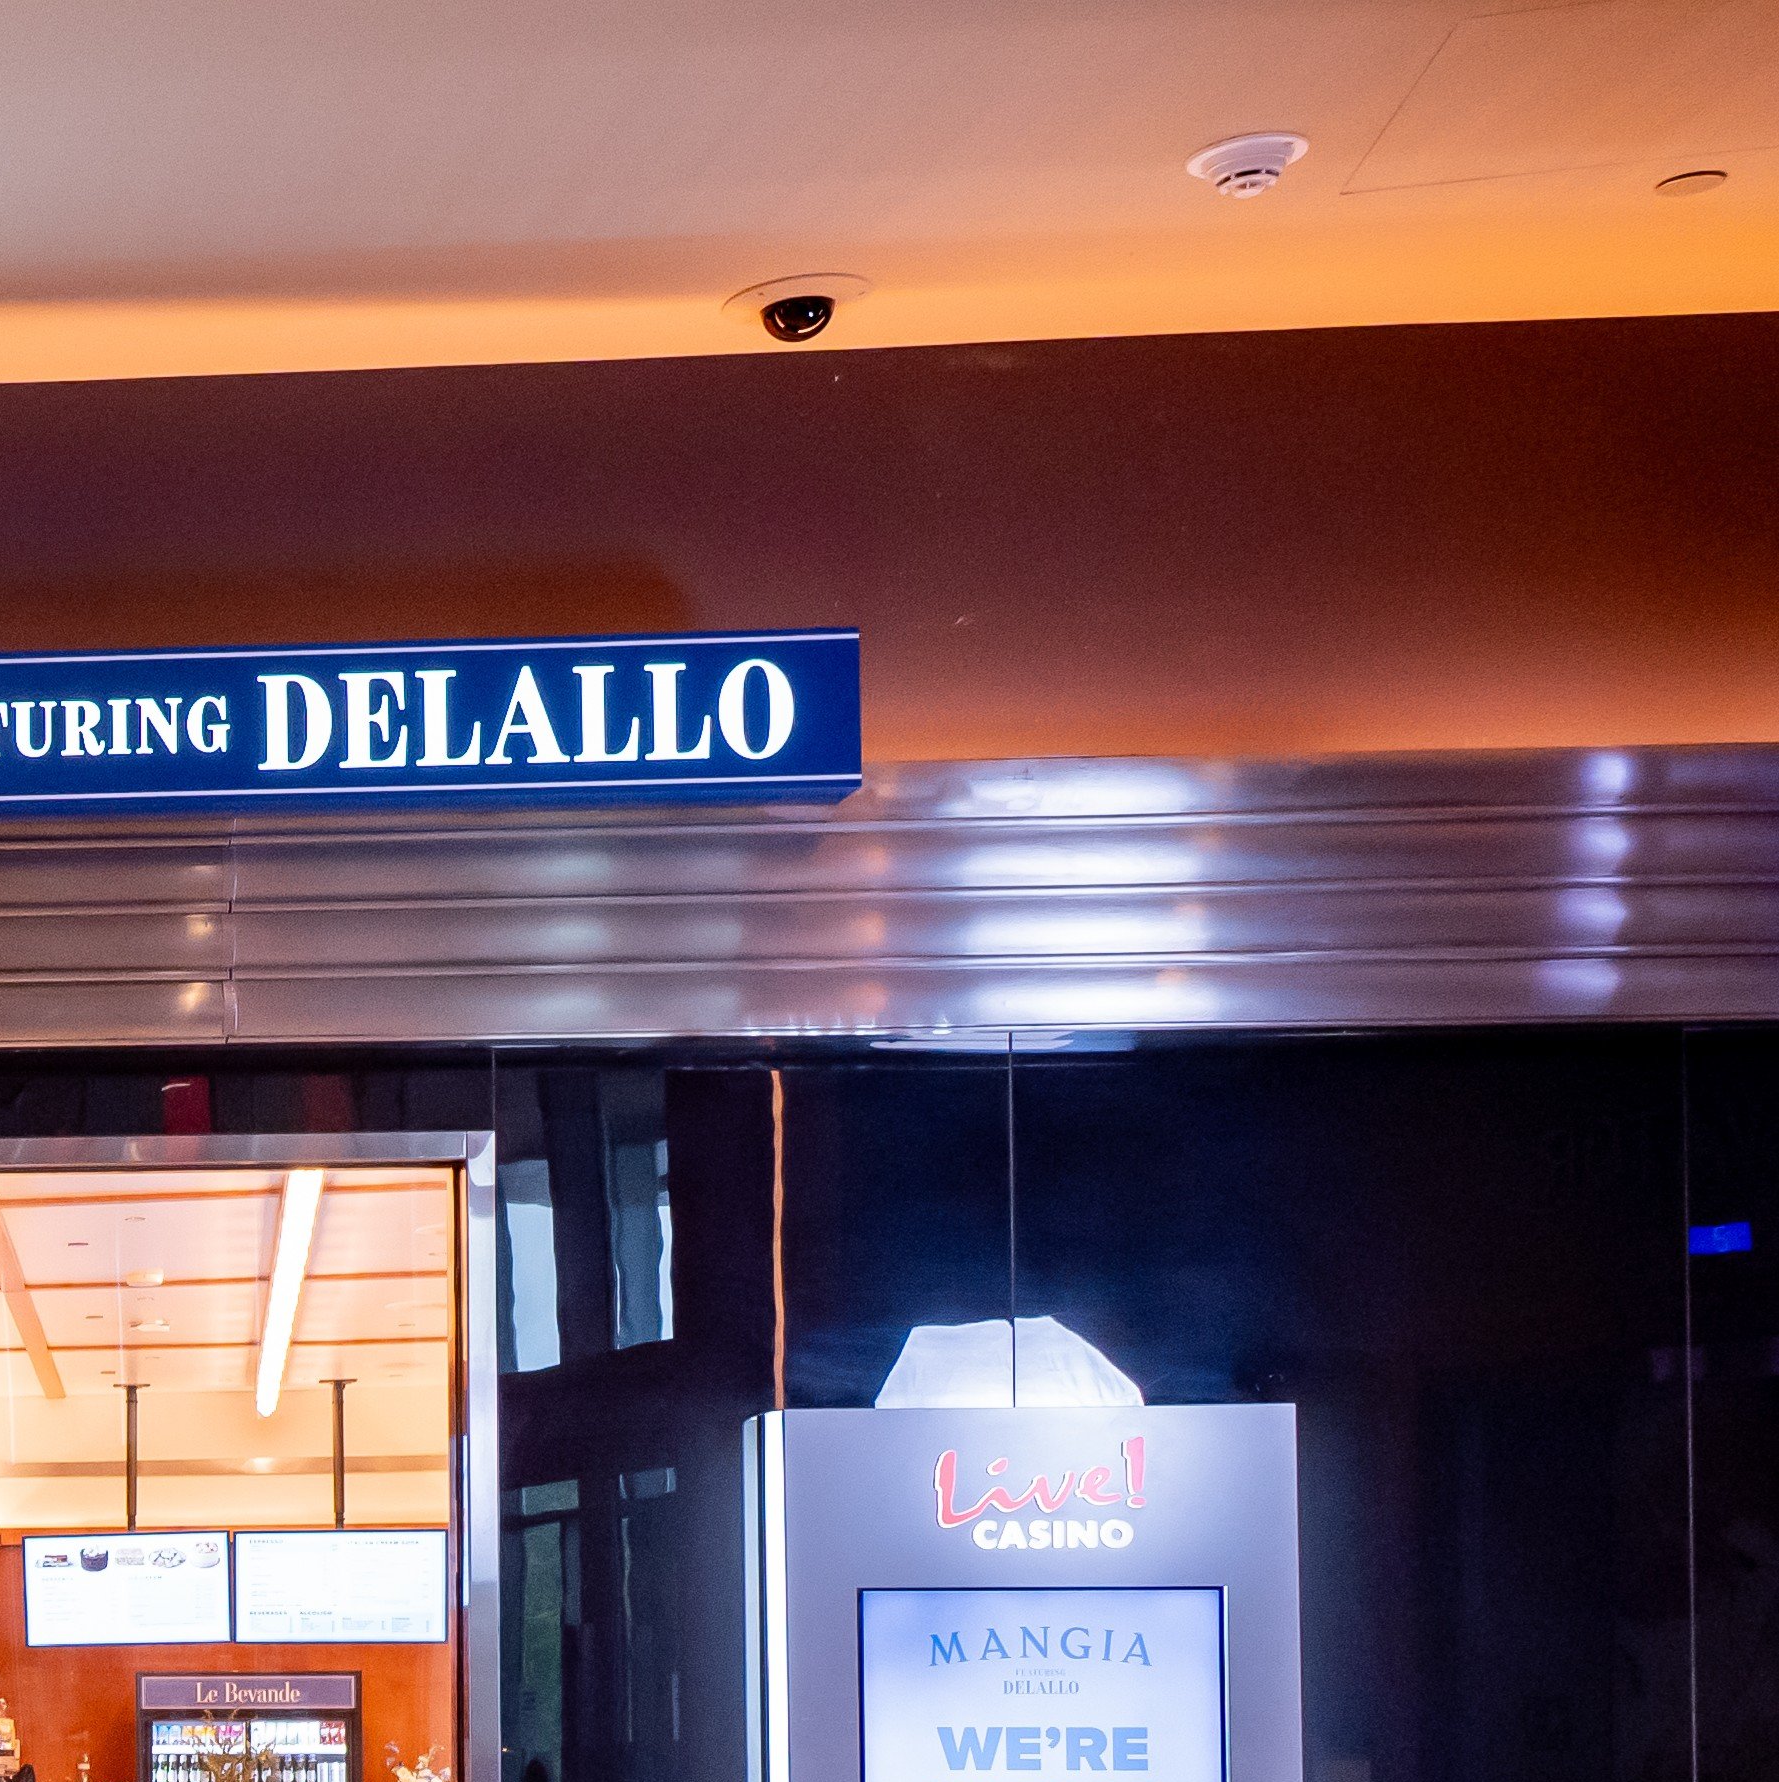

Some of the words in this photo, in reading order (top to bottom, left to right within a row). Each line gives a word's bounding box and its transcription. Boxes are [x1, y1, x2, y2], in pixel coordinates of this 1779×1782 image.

[255, 658, 795, 771] DELALLO
[933, 1436, 1147, 1528] Live!
[972, 1519, 1135, 1550] CASINO
[928, 1626, 1153, 1667] MANGIA
[196, 1682, 218, 1703] Le
[225, 1681, 301, 1704] Bevande
[1003, 1680, 1080, 1695] DELALLO
[937, 1727, 1149, 1771] WE'RE
